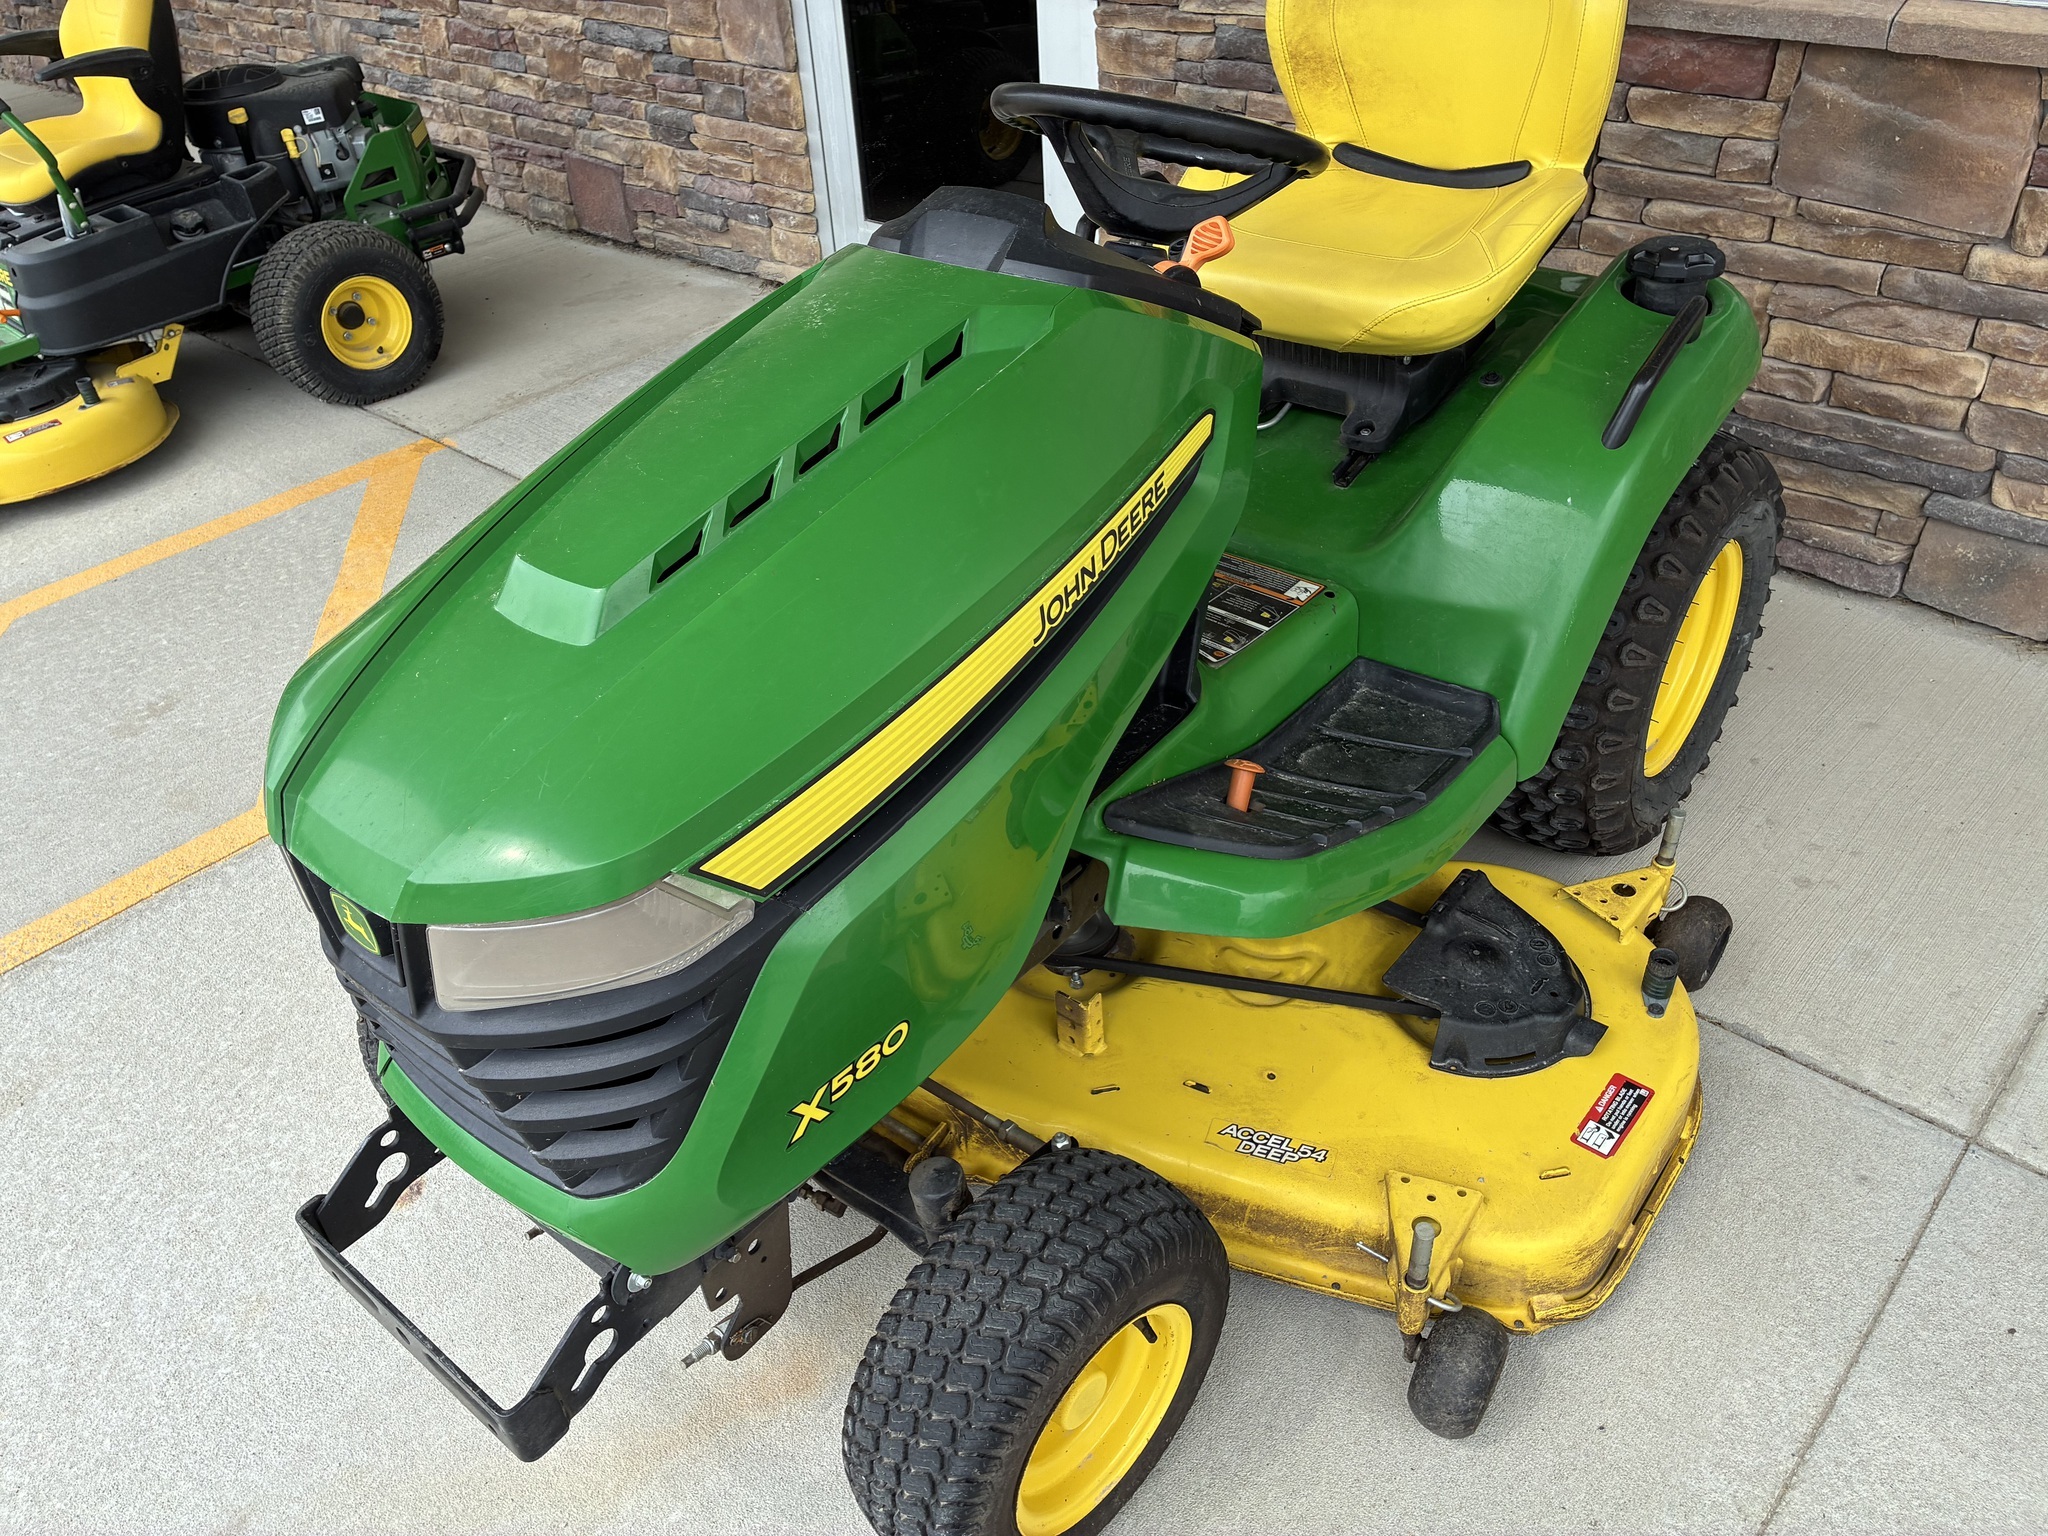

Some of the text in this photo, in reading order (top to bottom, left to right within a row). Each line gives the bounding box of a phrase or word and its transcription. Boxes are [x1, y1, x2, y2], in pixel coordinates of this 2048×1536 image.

[1033, 470, 1167, 644] JOHN DEERE
[786, 1020, 910, 1149] X580
[1598, 1084, 1617, 1106] DANGER
[1602, 1087, 1627, 1121] ROTATING BLADE
[1217, 1123, 1329, 1163] ACCEL 54
[1235, 1140, 1301, 1164] DEEP
